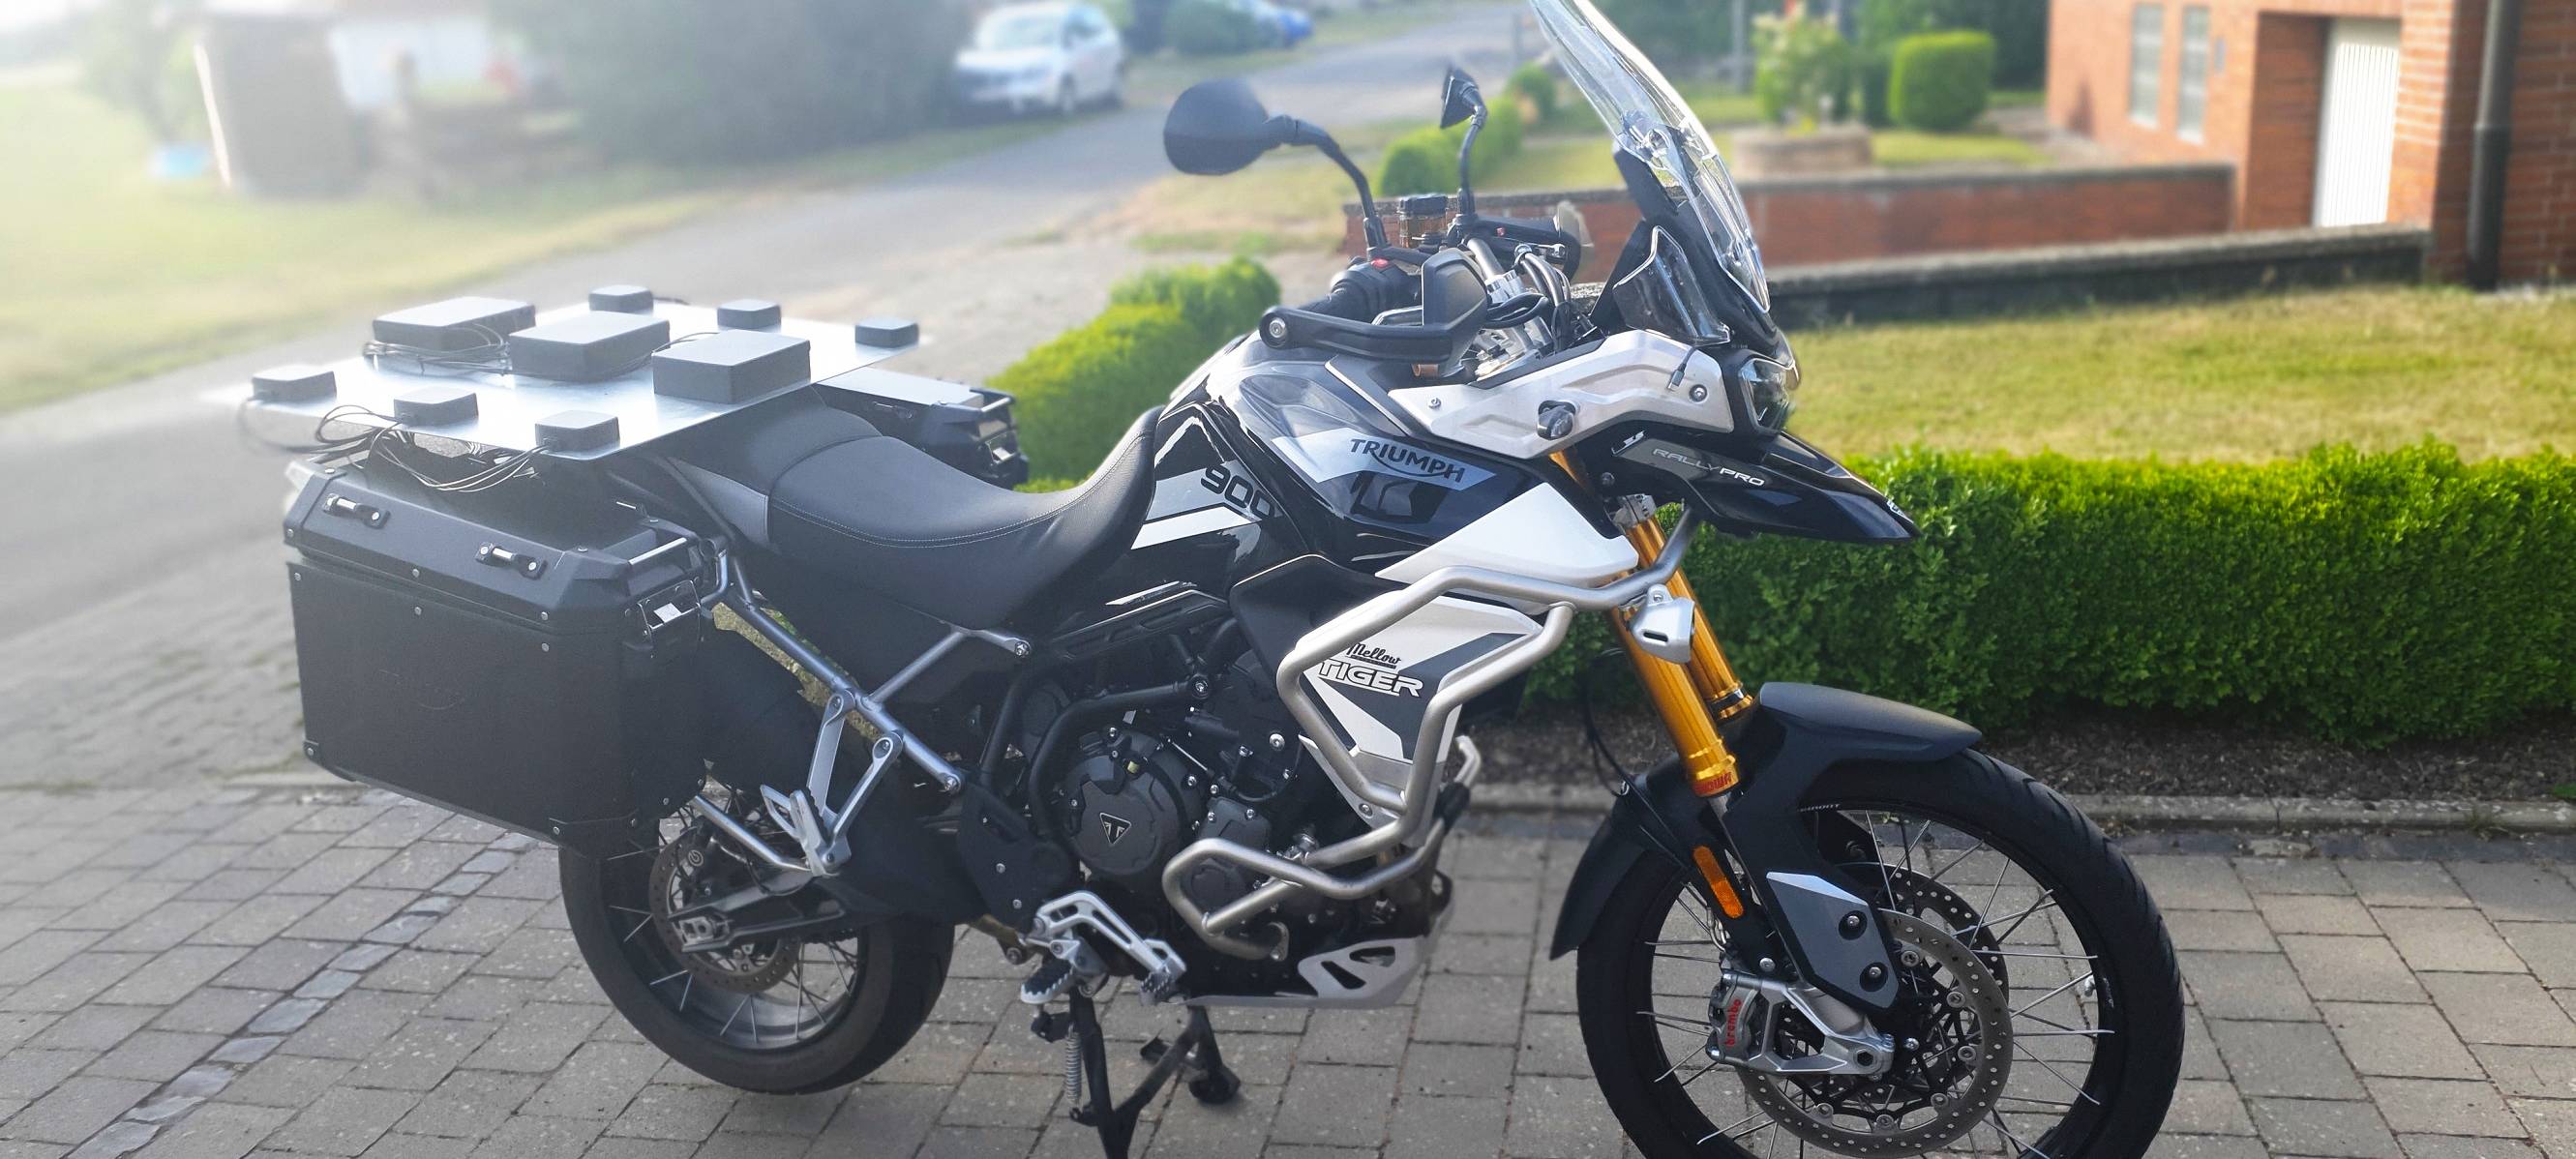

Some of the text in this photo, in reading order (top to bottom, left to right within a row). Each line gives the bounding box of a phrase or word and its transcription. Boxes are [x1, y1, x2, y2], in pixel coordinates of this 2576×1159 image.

[1350, 438, 1466, 483] TRIUMPH
[1720, 467, 1765, 487] PRO
[1201, 464, 1275, 519] 900
[1346, 641, 1402, 665] Mellow
[1318, 658, 1423, 698] TIGER
[1724, 998, 1742, 1047] brembo
